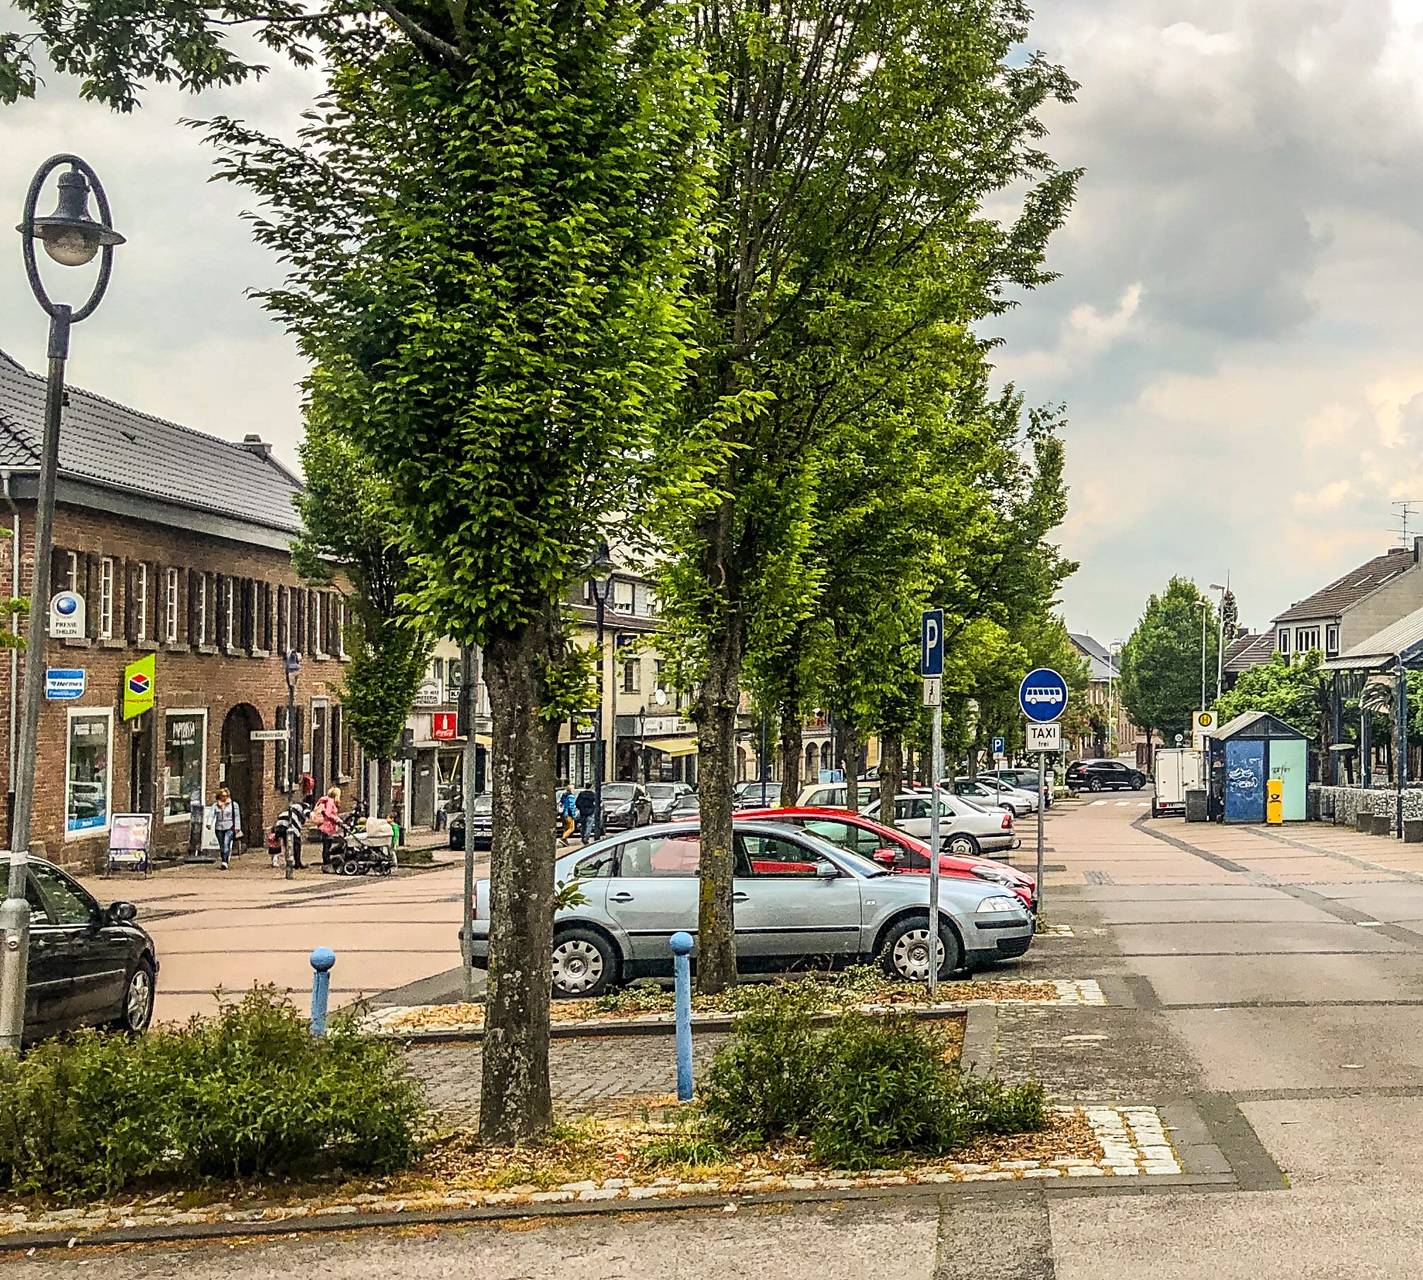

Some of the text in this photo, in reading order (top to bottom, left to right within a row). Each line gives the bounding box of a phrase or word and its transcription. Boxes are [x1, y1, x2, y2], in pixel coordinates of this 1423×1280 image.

[926, 619, 938, 668] P
[1031, 727, 1056, 739] TAXI
[994, 739, 1002, 752] P
